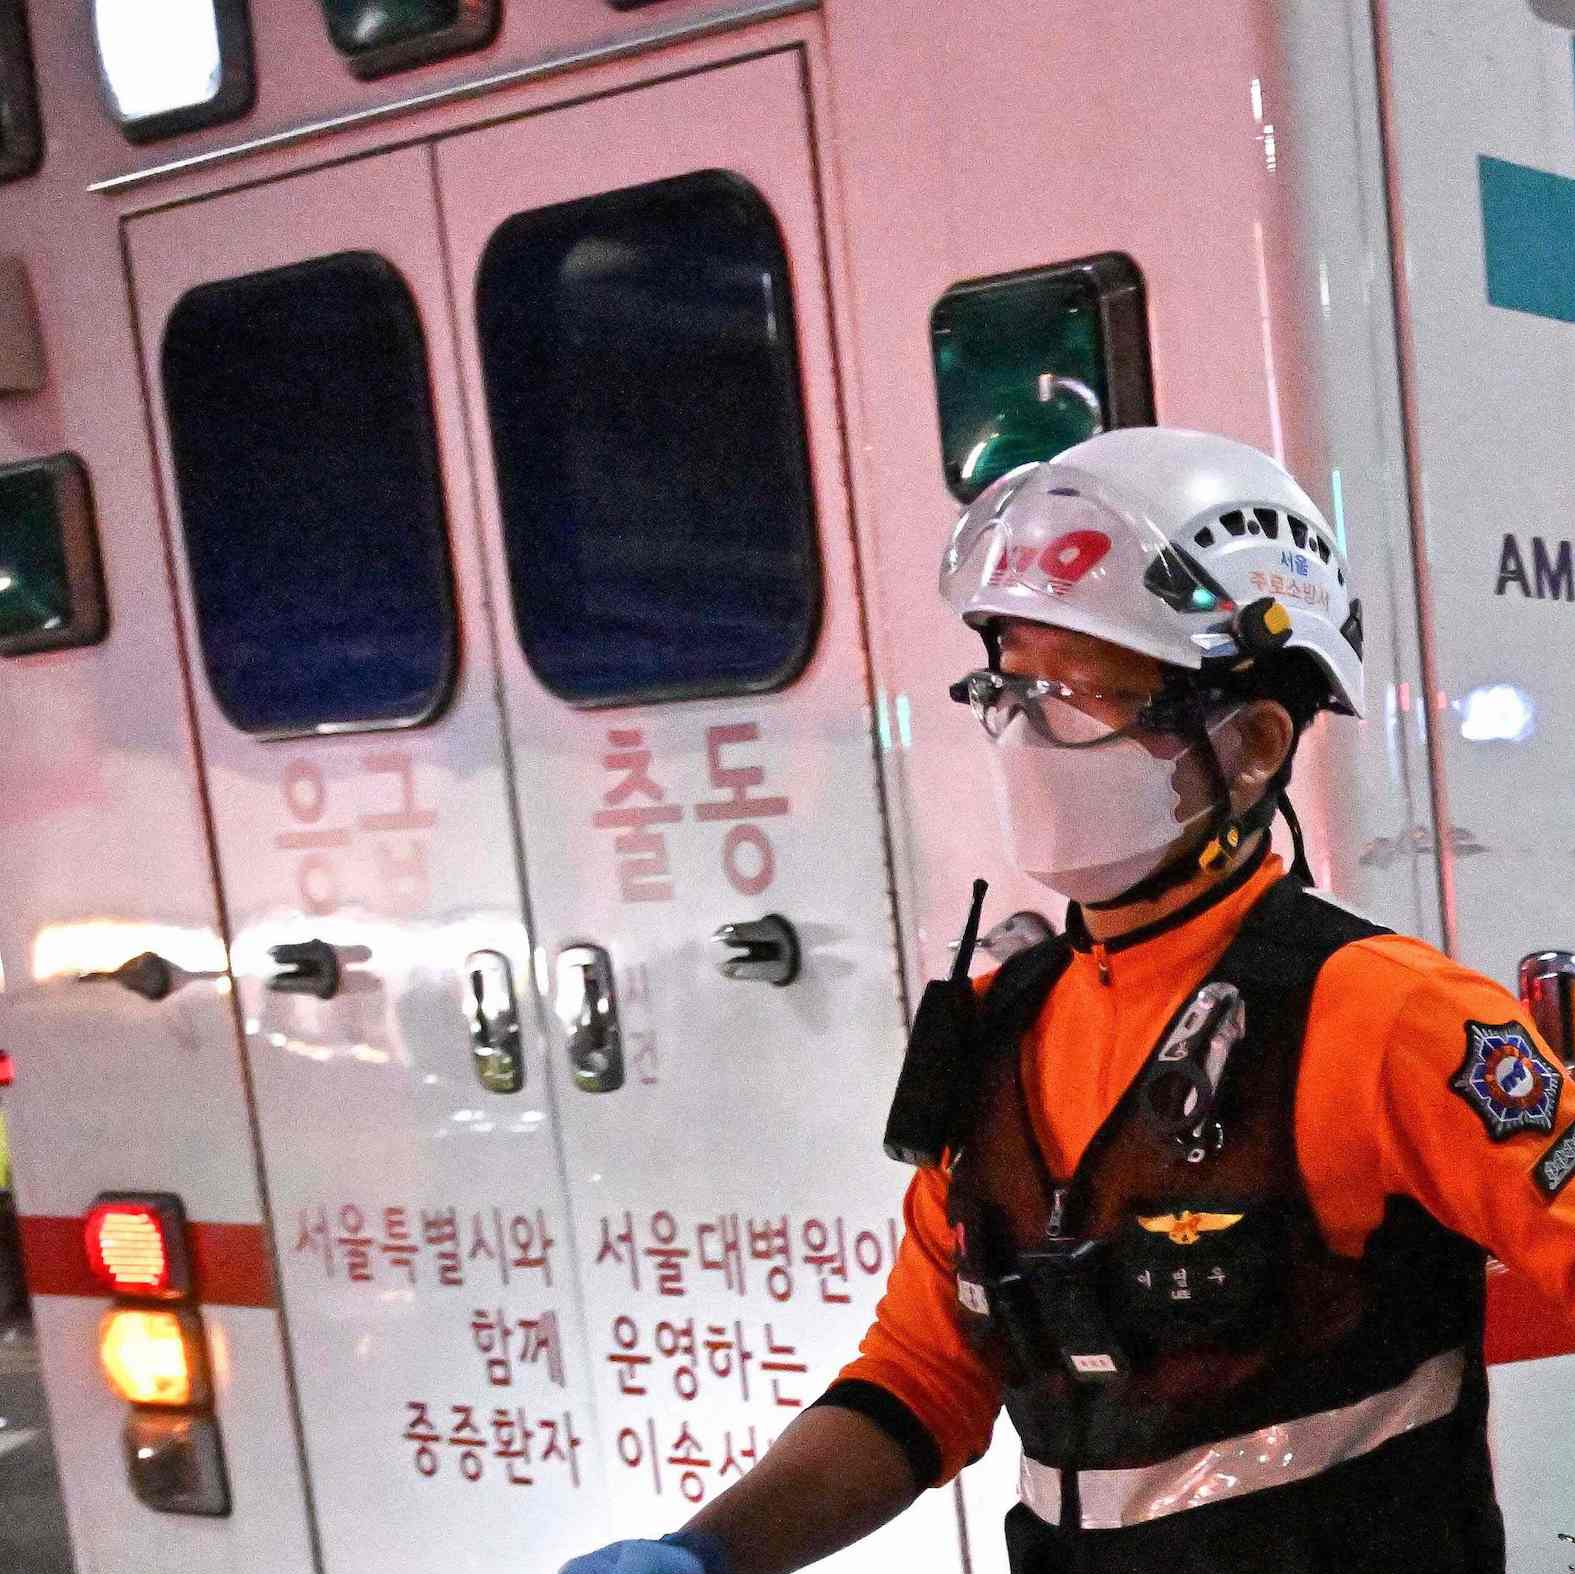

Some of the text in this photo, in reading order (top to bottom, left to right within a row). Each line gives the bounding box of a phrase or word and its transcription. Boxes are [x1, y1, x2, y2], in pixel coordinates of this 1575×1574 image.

[593, 720, 790, 902] 출동
[292, 1203, 556, 1287] 서울특별시와
[595, 1210, 900, 1302] 서울대병원이
[470, 1309, 808, 1407] 함께 운영하는
[402, 1400, 775, 1503] 중증환자 이송서
